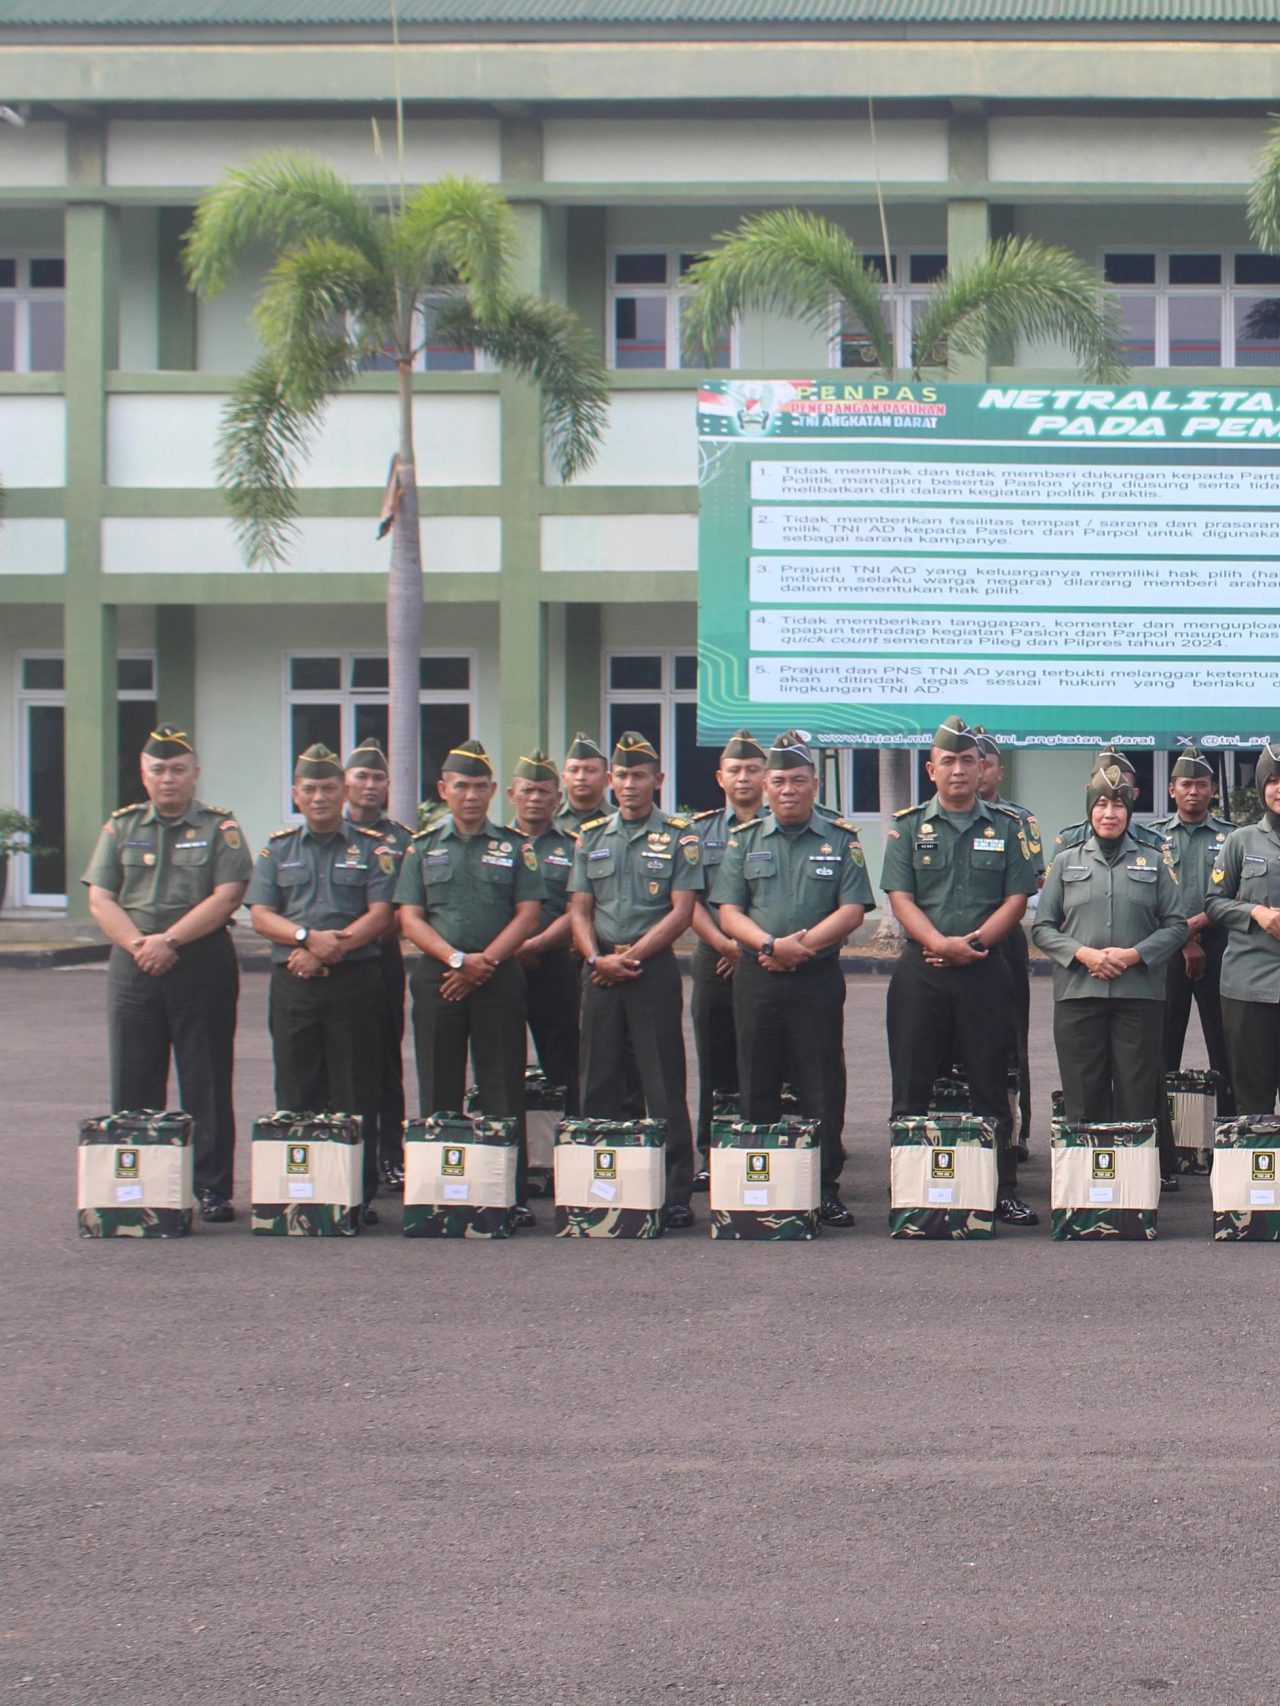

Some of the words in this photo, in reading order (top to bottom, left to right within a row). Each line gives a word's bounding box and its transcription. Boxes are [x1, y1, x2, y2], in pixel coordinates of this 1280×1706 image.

[796, 385, 938, 402] PENPAS
[791, 402, 883, 414] PENERANGAN
[883, 403, 946, 416] PASUKAN
[799, 415, 819, 427] TNI
[822, 415, 891, 428] ANGKATAN
[893, 416, 938, 429] DARAT
[1028, 415, 1167, 437] PADA
[759, 468, 772, 477] 1.
[782, 466, 828, 474] Tidak
[834, 466, 911, 475] memihak
[917, 467, 949, 476] dan
[954, 468, 995, 477] tidak
[1001, 469, 1076, 478] memberi
[1080, 470, 1166, 480] dukungan
[1171, 470, 1234, 481] kepada
[781, 475, 832, 484] Politik
[841, 477, 922, 487] manapun
[930, 477, 994, 486] beserta
[1003, 478, 1062, 487] Paslon
[1071, 480, 1112, 490] yang
[1121, 479, 1188, 490] diusung
[1198, 480, 1240, 489] serta
[781, 484, 874, 494] melibatkan
[878, 485, 905, 494] diri
[910, 486, 962, 495] dalam
[968, 487, 1040, 498] kegiatan
[1046, 487, 1095, 499] politik
[757, 515, 773, 524] 2.
[782, 514, 828, 523] Tidak
[836, 514, 942, 524] memberikan
[949, 516, 1014, 526] fasilitas
[1020, 518, 1079, 528] tempat
[1099, 520, 1158, 528] sarana
[1164, 519, 1197, 528] dan
[782, 524, 820, 532] milik
[830, 524, 860, 533] TNI
[868, 524, 895, 533] AD
[903, 525, 966, 536] kepada
[975, 526, 1034, 535] Paslon
[1041, 526, 1074, 536] dan
[1082, 527, 1138, 538] Parpol
[1146, 528, 1193, 537] untuk
[782, 533, 849, 544] sebagai
[854, 535, 913, 543] sarana
[757, 565, 771, 574] 3.
[780, 564, 840, 575] Prajurit
[852, 565, 880, 573] TNI
[889, 565, 916, 574] AD
[925, 568, 967, 577] yang
[976, 567, 1080, 578] keluarganya
[1089, 568, 1159, 578] memiliki
[1168, 569, 1199, 578] hak
[1207, 569, 1242, 579] pilih
[780, 574, 845, 583] individu
[856, 574, 912, 584] selaku
[922, 575, 975, 586] warga
[986, 575, 1052, 587] negara)
[1062, 576, 1132, 588] dilarang
[1142, 577, 1218, 587] memberi
[779, 583, 832, 592] dalam
[837, 583, 943, 593] menentukan
[948, 584, 979, 594] hak
[755, 616, 772, 625] 4.
[781, 615, 826, 624] Tidak
[835, 616, 941, 626] memberikan
[1054, 619, 1134, 628] komentar
[1142, 620, 1174, 629] dan
[780, 626, 844, 636] apapun
[849, 625, 926, 636] terhadap
[931, 626, 1004, 637] kegiatan
[1009, 627, 1069, 637] Paslon
[1074, 628, 1106, 637] dan
[1112, 628, 1168, 639] Parpol
[1173, 628, 1242, 640] maupun
[780, 634, 824, 645] quick
[830, 635, 878, 644] count
[882, 635, 973, 645] sementara
[978, 636, 1021, 648] Pileg
[1025, 637, 1058, 646] dan
[1063, 637, 1122, 648] Pilpres
[1126, 637, 1175, 647] tahun
[755, 666, 770, 675] 5.
[779, 665, 840, 675] Prajurit
[844, 665, 877, 674] dan
[882, 666, 922, 675] PNS
[928, 666, 958, 675] TNI
[962, 667, 990, 676] AD
[994, 669, 1036, 678] yang
[1041, 668, 1105, 677] terbukti
[1110, 668, 1201, 679] melanggar
[779, 673, 821, 683] akan
[837, 675, 904, 684] ditindak
[921, 676, 968, 687] tegas
[985, 676, 1041, 686] sesuai
[1058, 677, 1116, 687] hukum
[1132, 677, 1175, 688] yang
[1192, 678, 1254, 688] berlaku
[779, 683, 872, 695] lingkungan
[877, 684, 908, 693] TNI
[1200, 734, 1271, 747] @tni_ad
